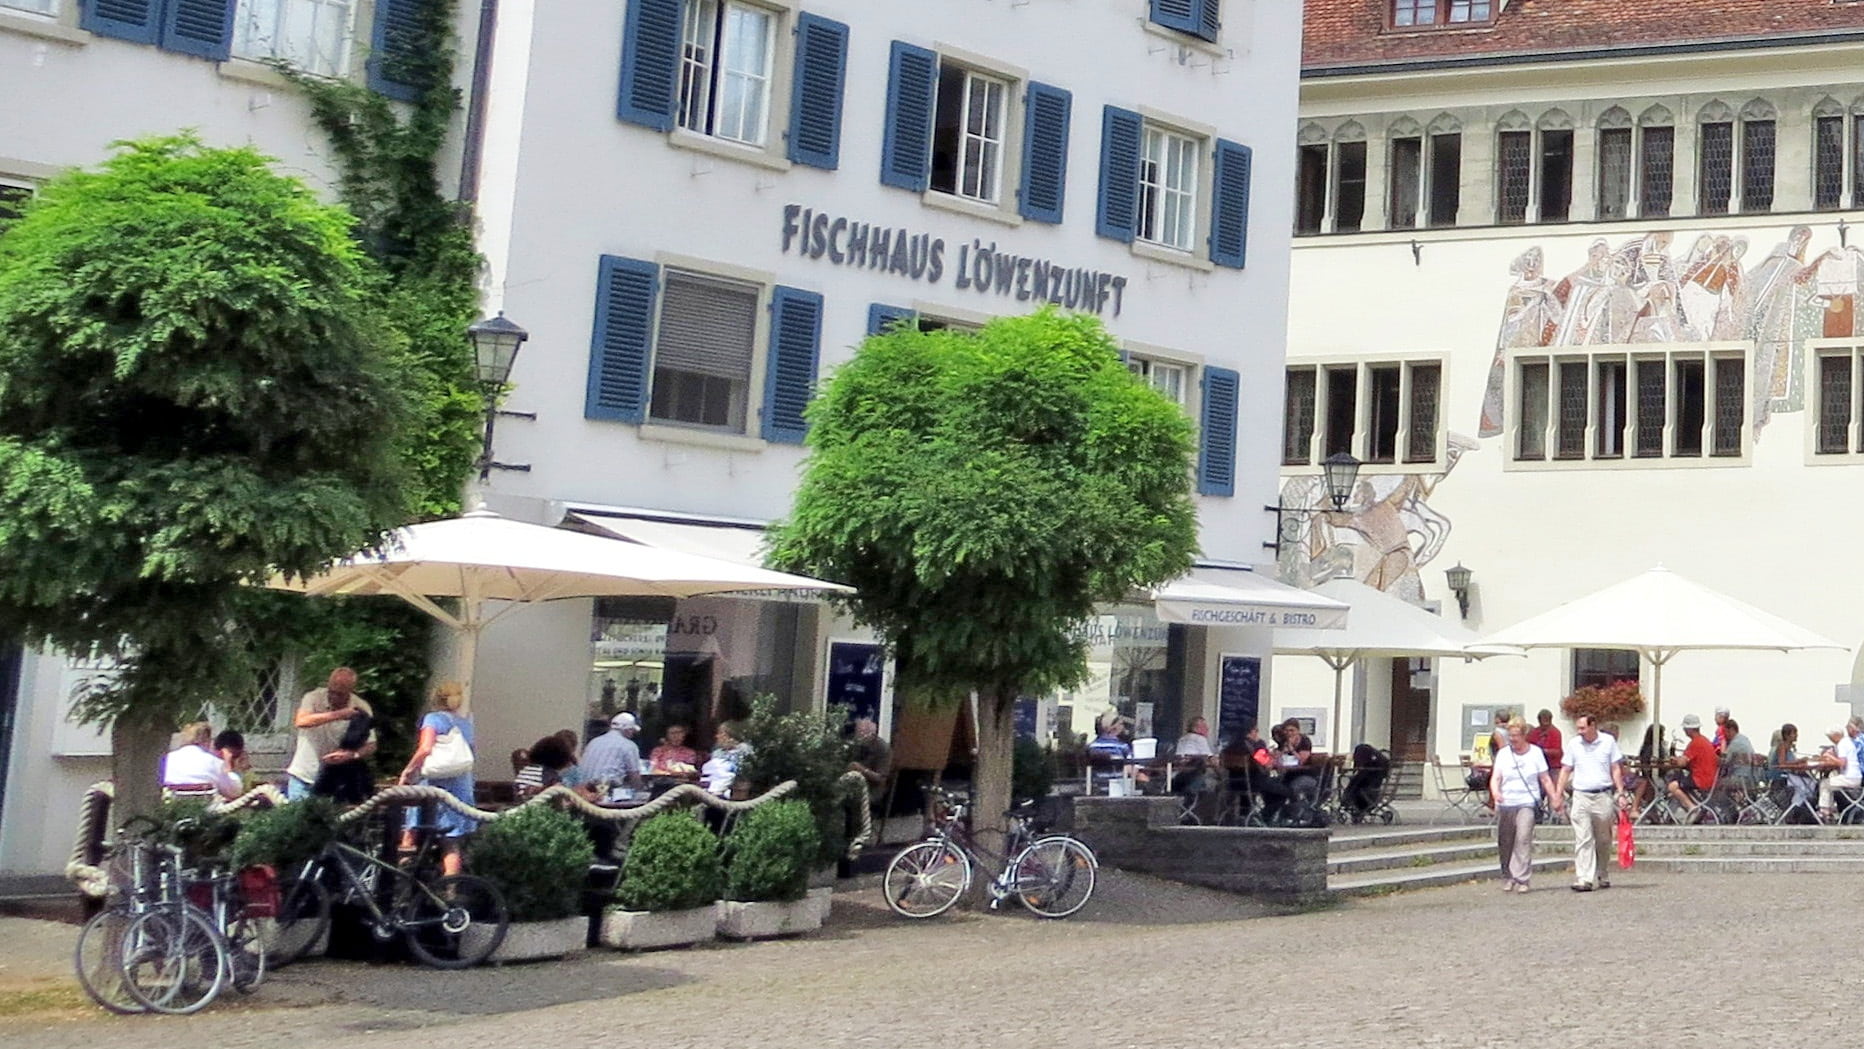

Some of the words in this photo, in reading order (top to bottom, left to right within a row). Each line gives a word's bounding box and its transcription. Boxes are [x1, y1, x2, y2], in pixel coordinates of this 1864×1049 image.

[782, 204, 945, 284] FISCHHAUS
[956, 237, 1128, 318] LÖWENZUNFT
[1283, 613, 1316, 626] BISTRO
